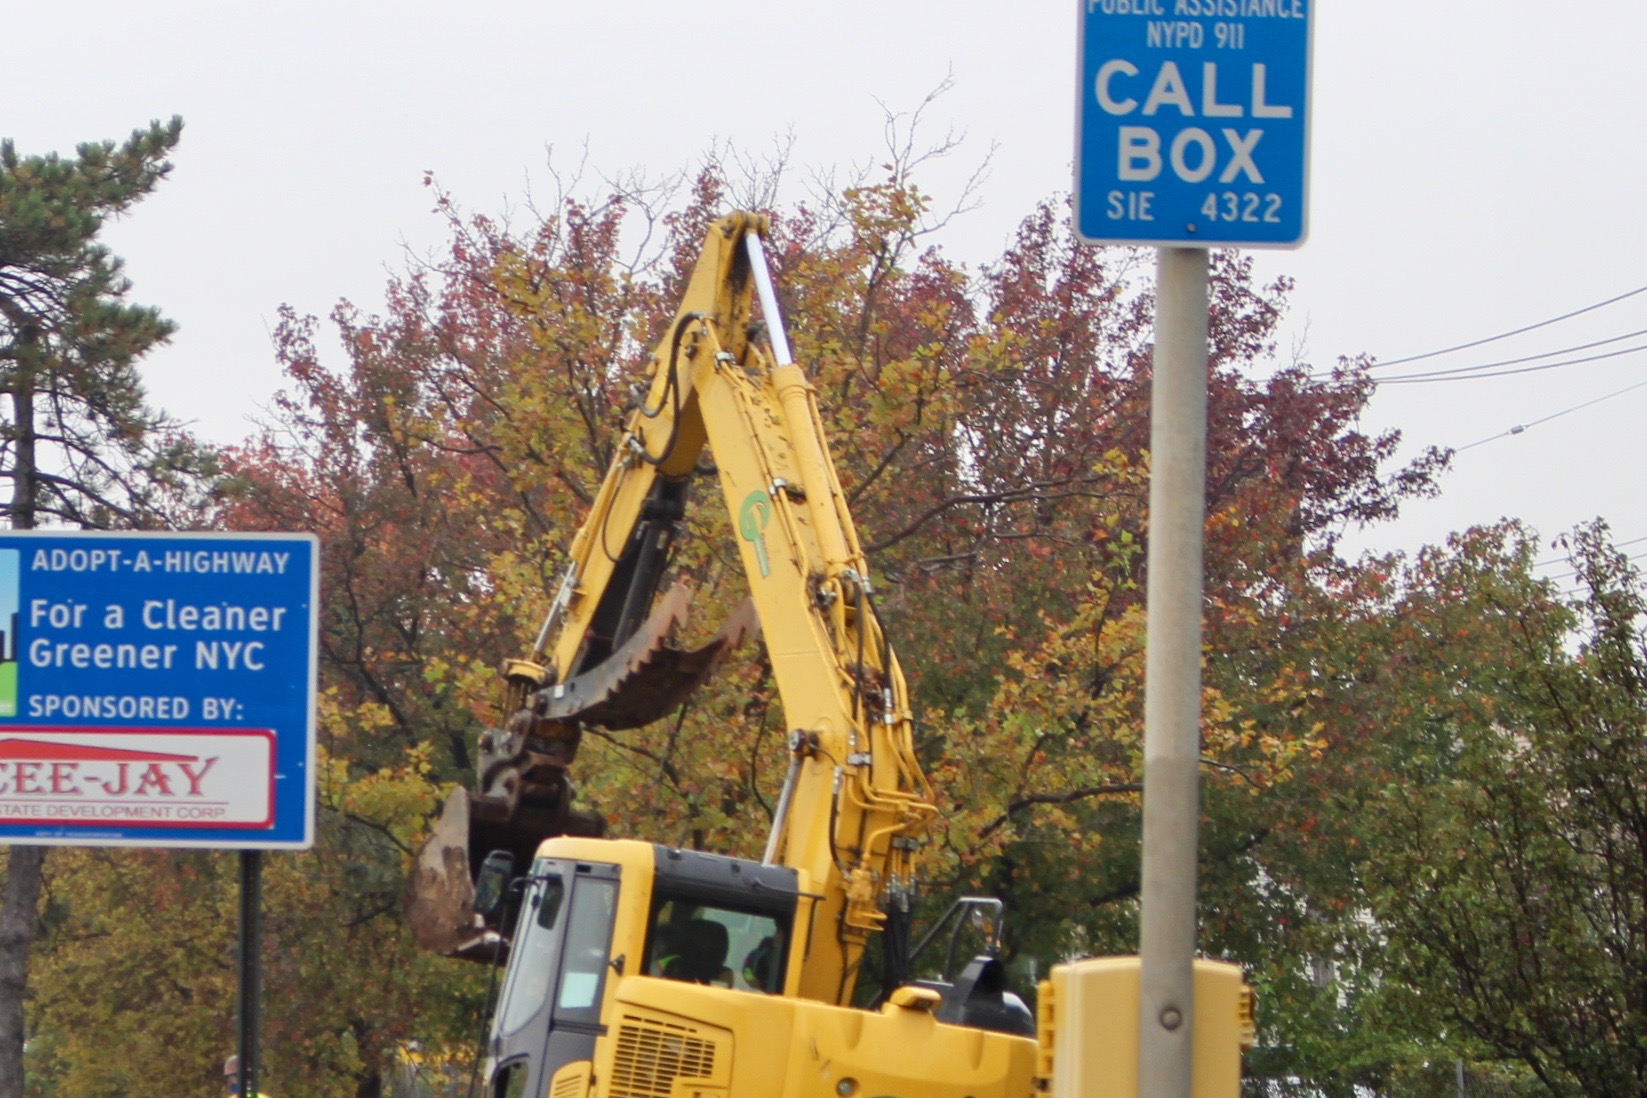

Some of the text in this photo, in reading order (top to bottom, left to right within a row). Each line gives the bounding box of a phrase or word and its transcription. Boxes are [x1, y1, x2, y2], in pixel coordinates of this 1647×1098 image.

[1147, 21, 1245, 49] NYPD 911
[1095, 59, 1293, 119] CALL
[1118, 126, 1266, 184] BOX
[1107, 191, 1283, 222] SIE 4322
[31, 549, 289, 574] ADOPT-A-HIGHWAY
[30, 599, 286, 631] For a Cleaner
[29, 639, 265, 671] Greener NYC
[29, 695, 189, 719] SPONSORED
[203, 697, 244, 721] BY:
[46, 805, 171, 819] DEVELOPMENT
